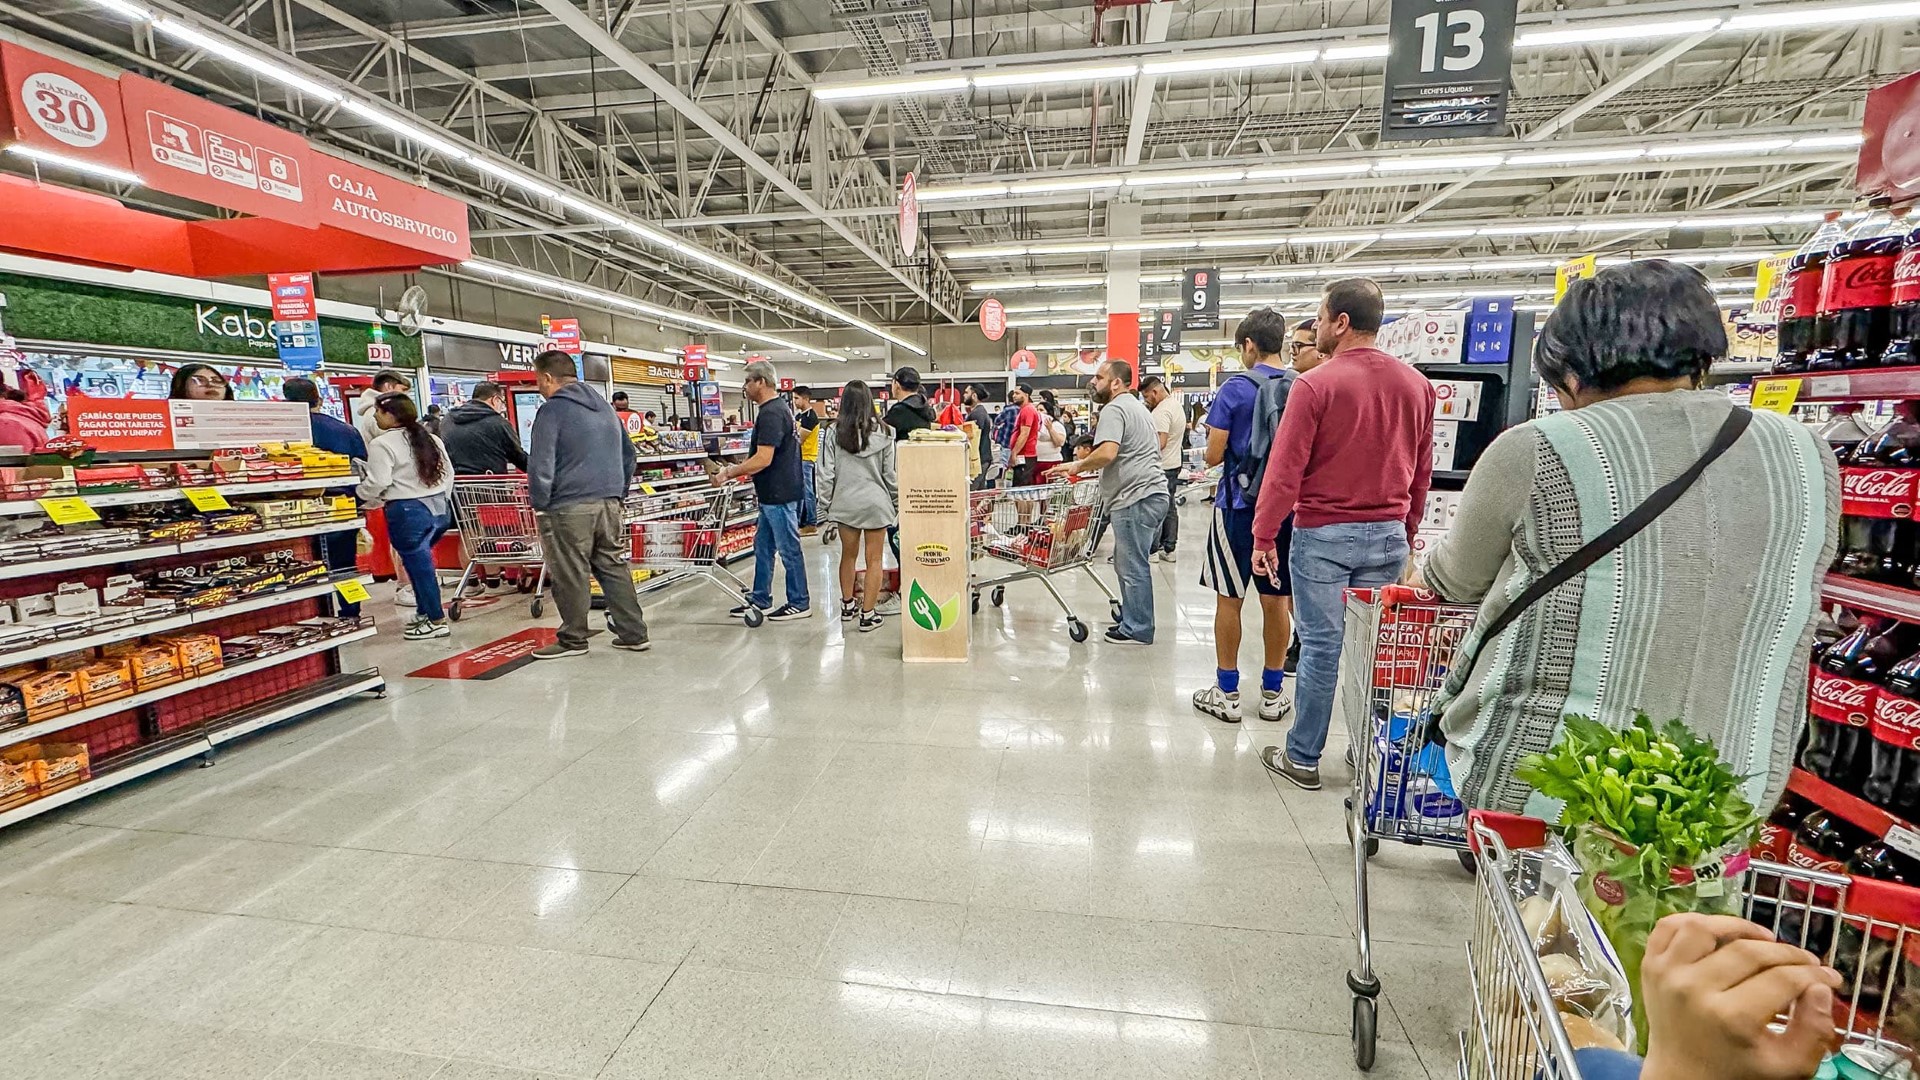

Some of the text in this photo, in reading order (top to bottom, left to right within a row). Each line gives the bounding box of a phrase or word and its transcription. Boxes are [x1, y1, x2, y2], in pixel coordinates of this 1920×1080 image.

[1414, 9, 1485, 73] 13
[1420, 87, 1444, 95] LECHES
[35, 90, 96, 132] 30
[262, 180, 271, 189] 3
[328, 173, 378, 201] CAJA
[331, 197, 458, 244] AUTOSERVICIO
[1561, 262, 1586, 275] OFERTA
[1193, 290, 1207, 310] 9
[1161, 325, 1172, 340] 7
[1145, 344, 1154, 356] 5
[688, 368, 695, 378] 6
[783, 380, 789, 389] 5
[77, 411, 113, 422] ¿SABÍAS
[114, 413, 131, 421] QUE
[78, 421, 107, 429] PAGAR
[108, 421, 126, 429] CON
[629, 420, 639, 430] 30
[79, 429, 122, 437] GIFTCARD
[129, 429, 162, 437] UNIPAY?
[915, 556, 951, 564] CONSUMO
